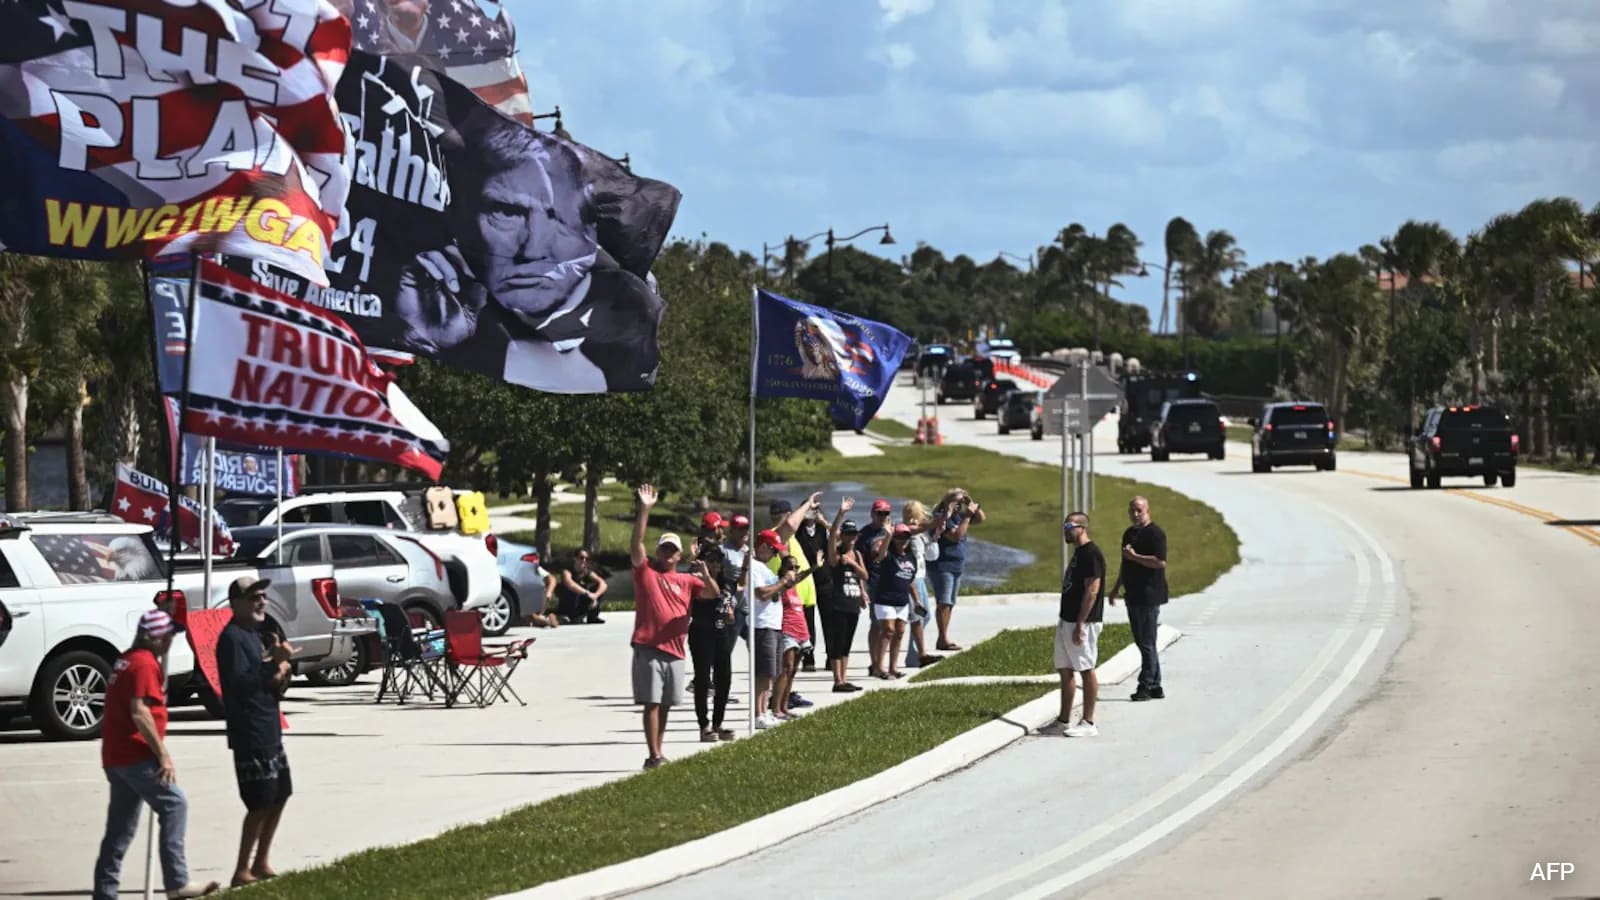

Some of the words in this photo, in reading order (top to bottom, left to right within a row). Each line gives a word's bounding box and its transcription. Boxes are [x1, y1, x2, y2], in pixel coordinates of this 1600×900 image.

[63, 1, 281, 105] THE
[45, 196, 322, 266] WWG1WGA
[252, 258, 300, 299] Save
[304, 280, 382, 318] America
